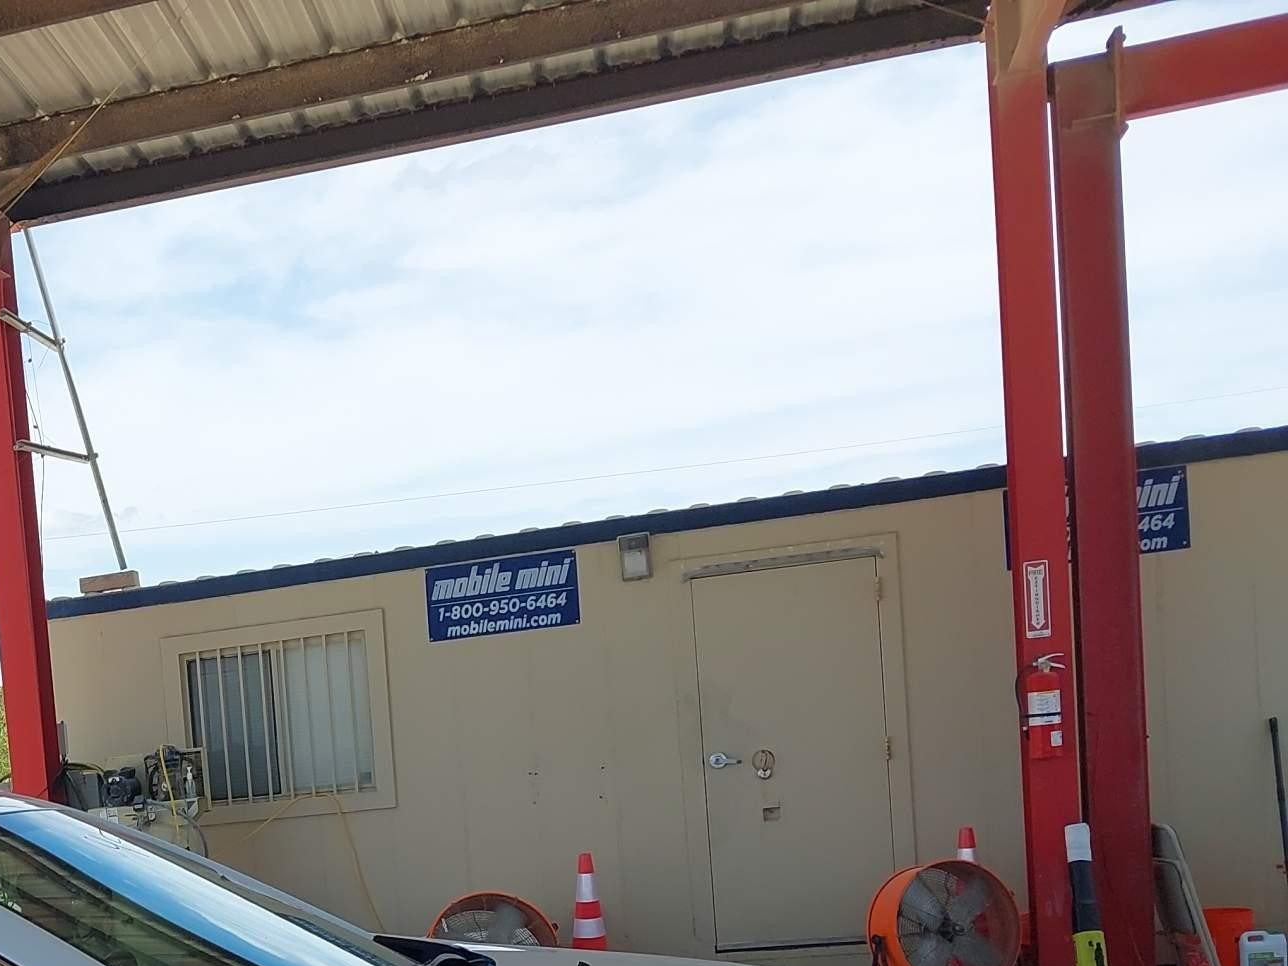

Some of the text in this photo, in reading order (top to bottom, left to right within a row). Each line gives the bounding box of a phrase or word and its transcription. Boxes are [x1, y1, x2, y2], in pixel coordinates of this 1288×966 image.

[1136, 475, 1181, 509] ini
[431, 558, 572, 601] mobile mini
[438, 592, 567, 622] 1-800-950-6464
[447, 612, 562, 638] mobilemini.com
